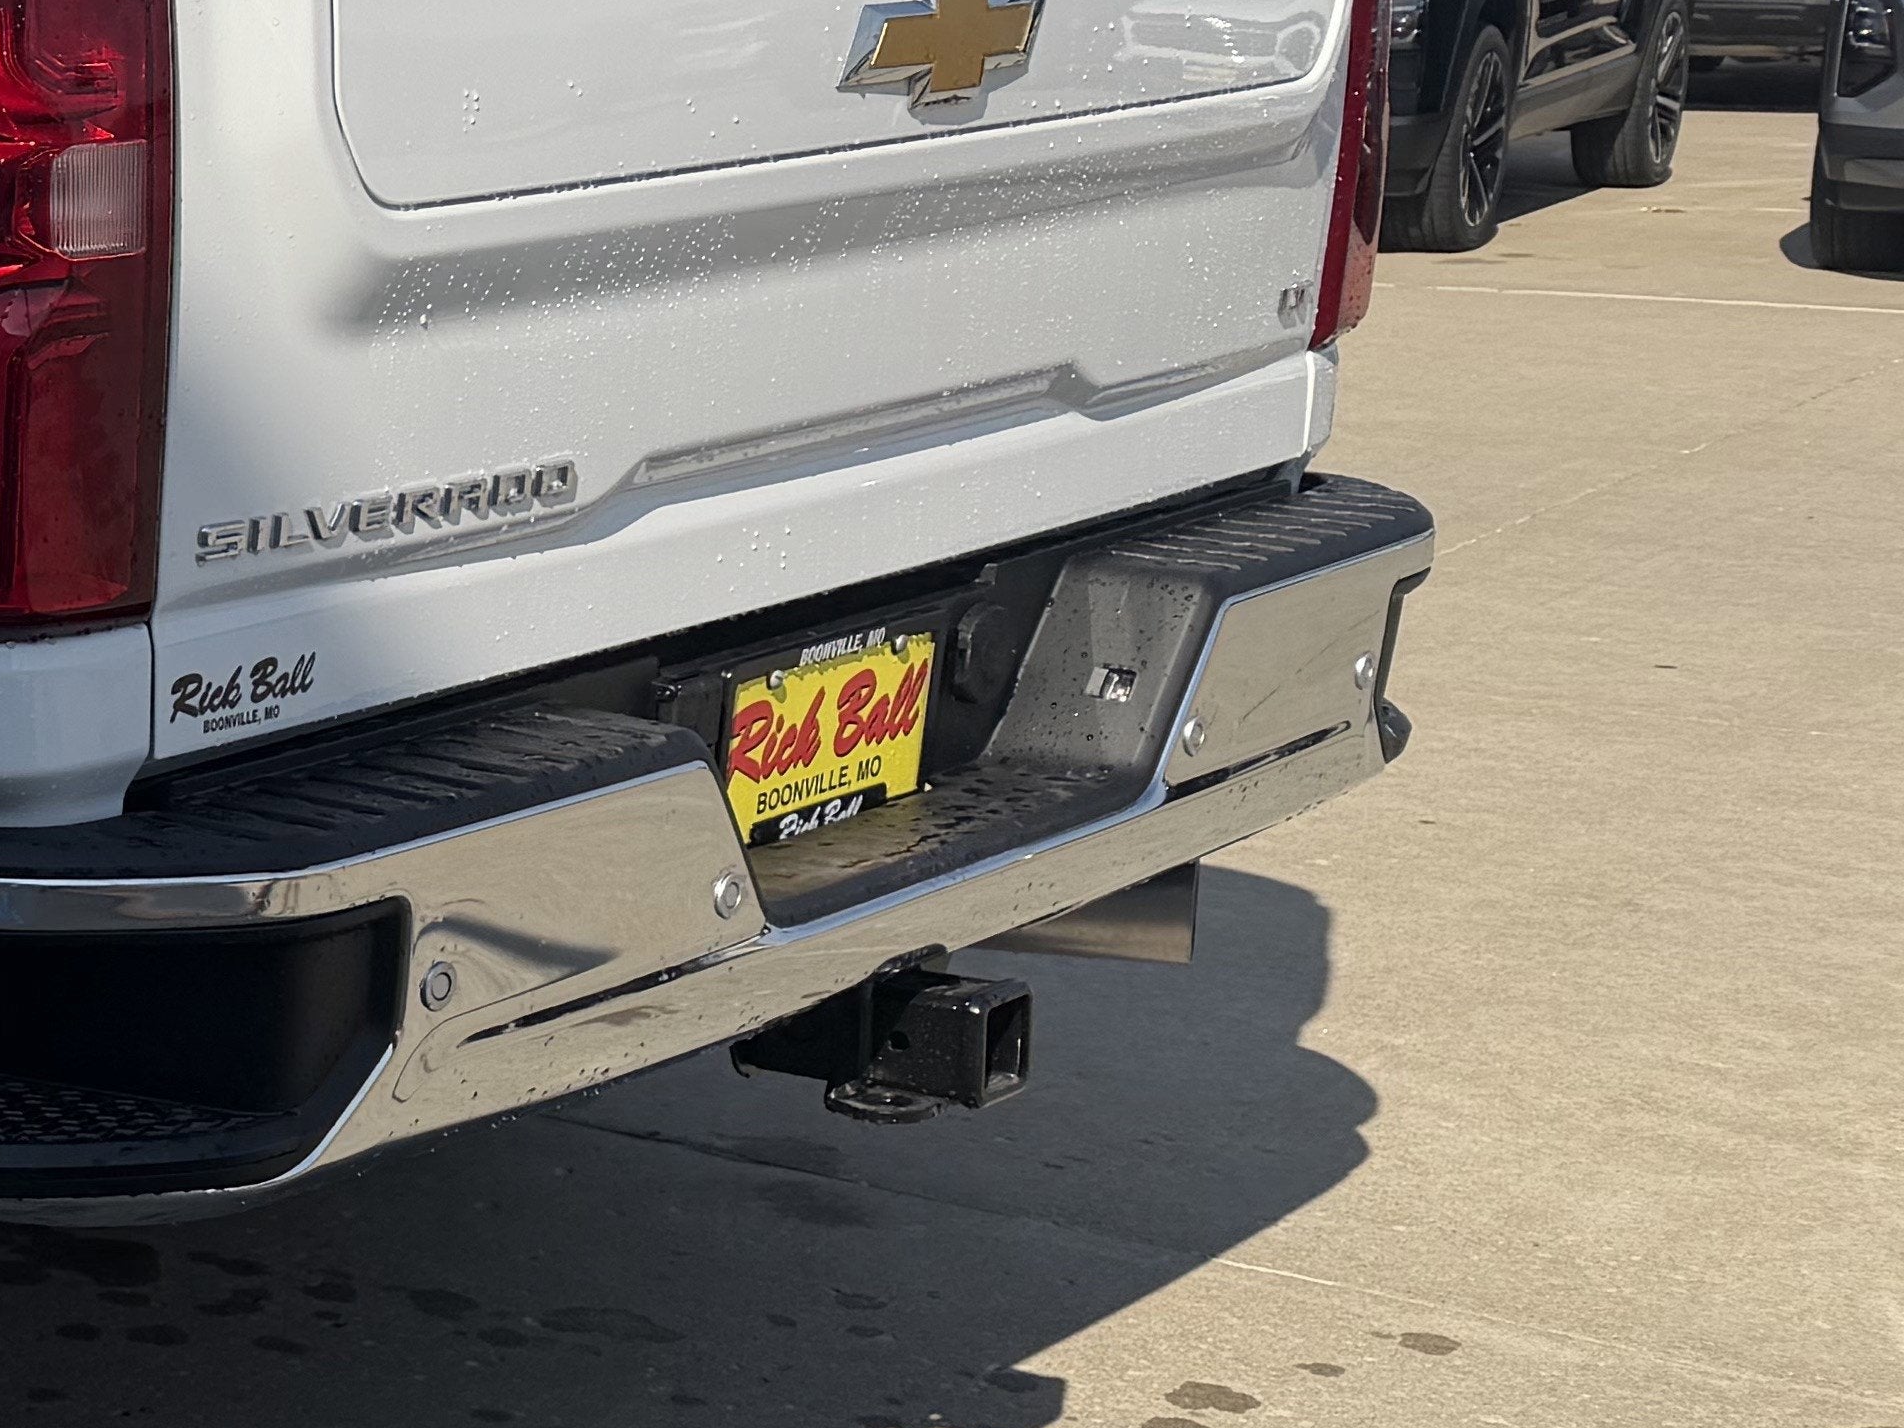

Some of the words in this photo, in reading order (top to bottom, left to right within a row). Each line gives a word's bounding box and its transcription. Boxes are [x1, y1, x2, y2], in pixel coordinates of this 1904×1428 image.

[195, 459, 579, 566] SILVERADO
[799, 632, 863, 666] BOONVILLE,
[866, 626, 886, 648] MO
[170, 664, 243, 723] Rick
[250, 651, 316, 703] Ball
[203, 709, 262, 734] BOONVILLE,
[264, 704, 280, 719] MO
[727, 685, 826, 791] Rick
[833, 659, 929, 757] Ball
[756, 764, 852, 815] BOONVILLE,
[857, 754, 882, 782] MO
